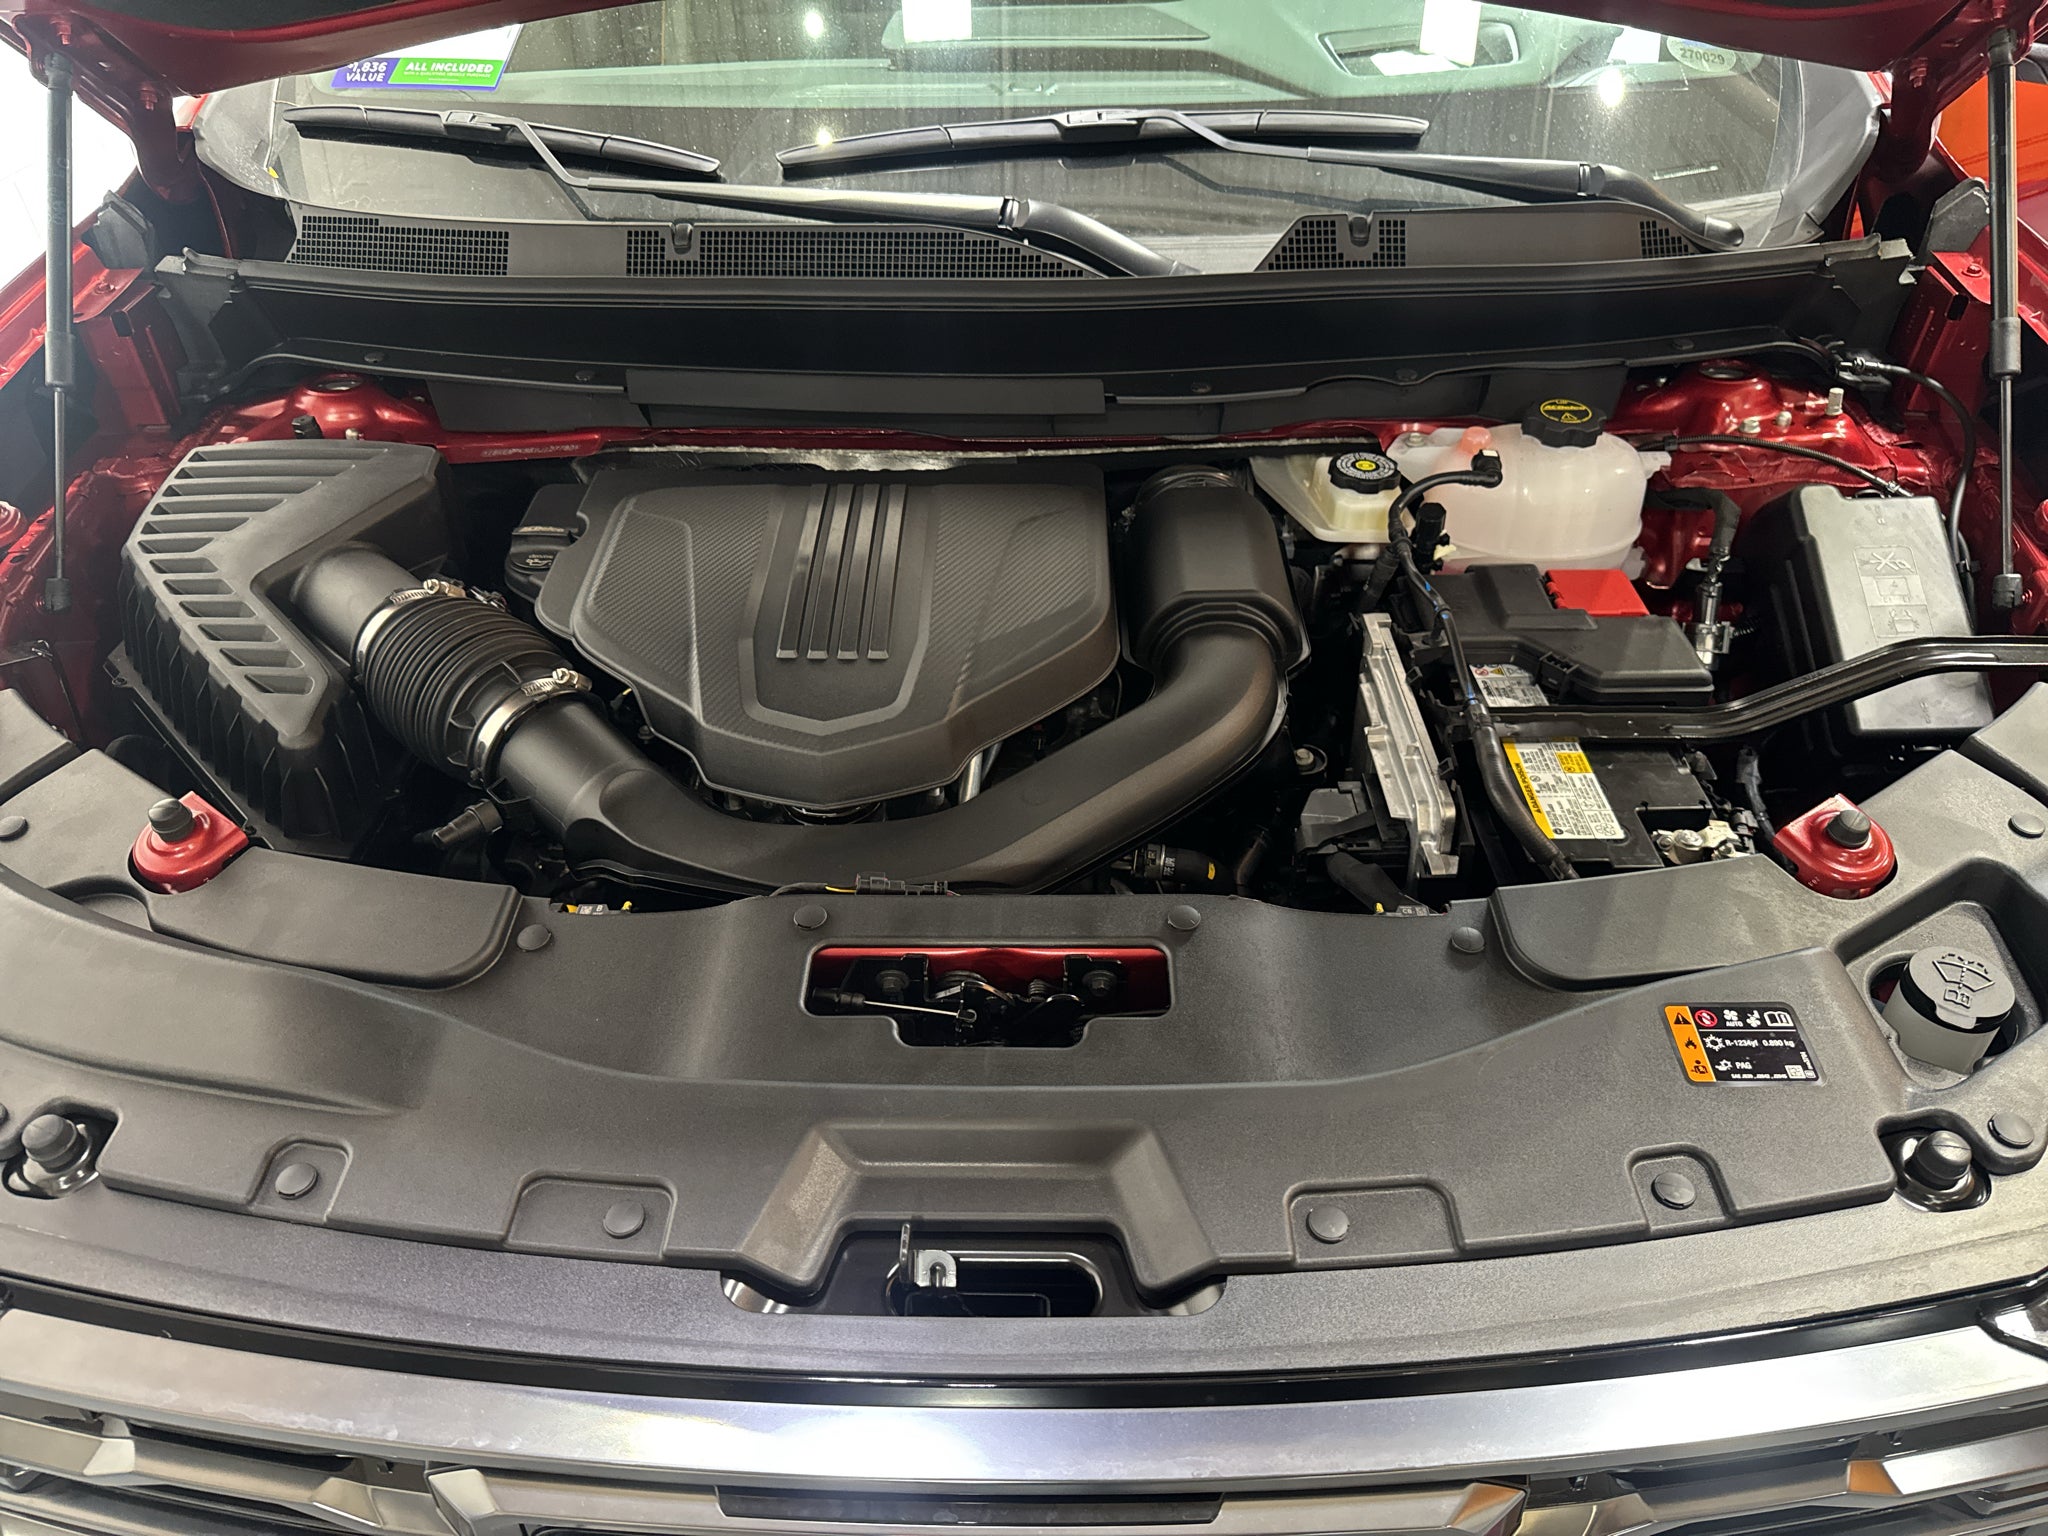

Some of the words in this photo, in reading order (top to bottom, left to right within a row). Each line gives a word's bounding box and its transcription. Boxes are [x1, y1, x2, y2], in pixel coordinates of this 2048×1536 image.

[1680, 48, 1725, 65] 270029
[405, 62, 428, 71] ALL
[430, 62, 494, 73] INCLUDED
[346, 72, 386, 82] VALUE
[1735, 1061, 1753, 1069] PAG
